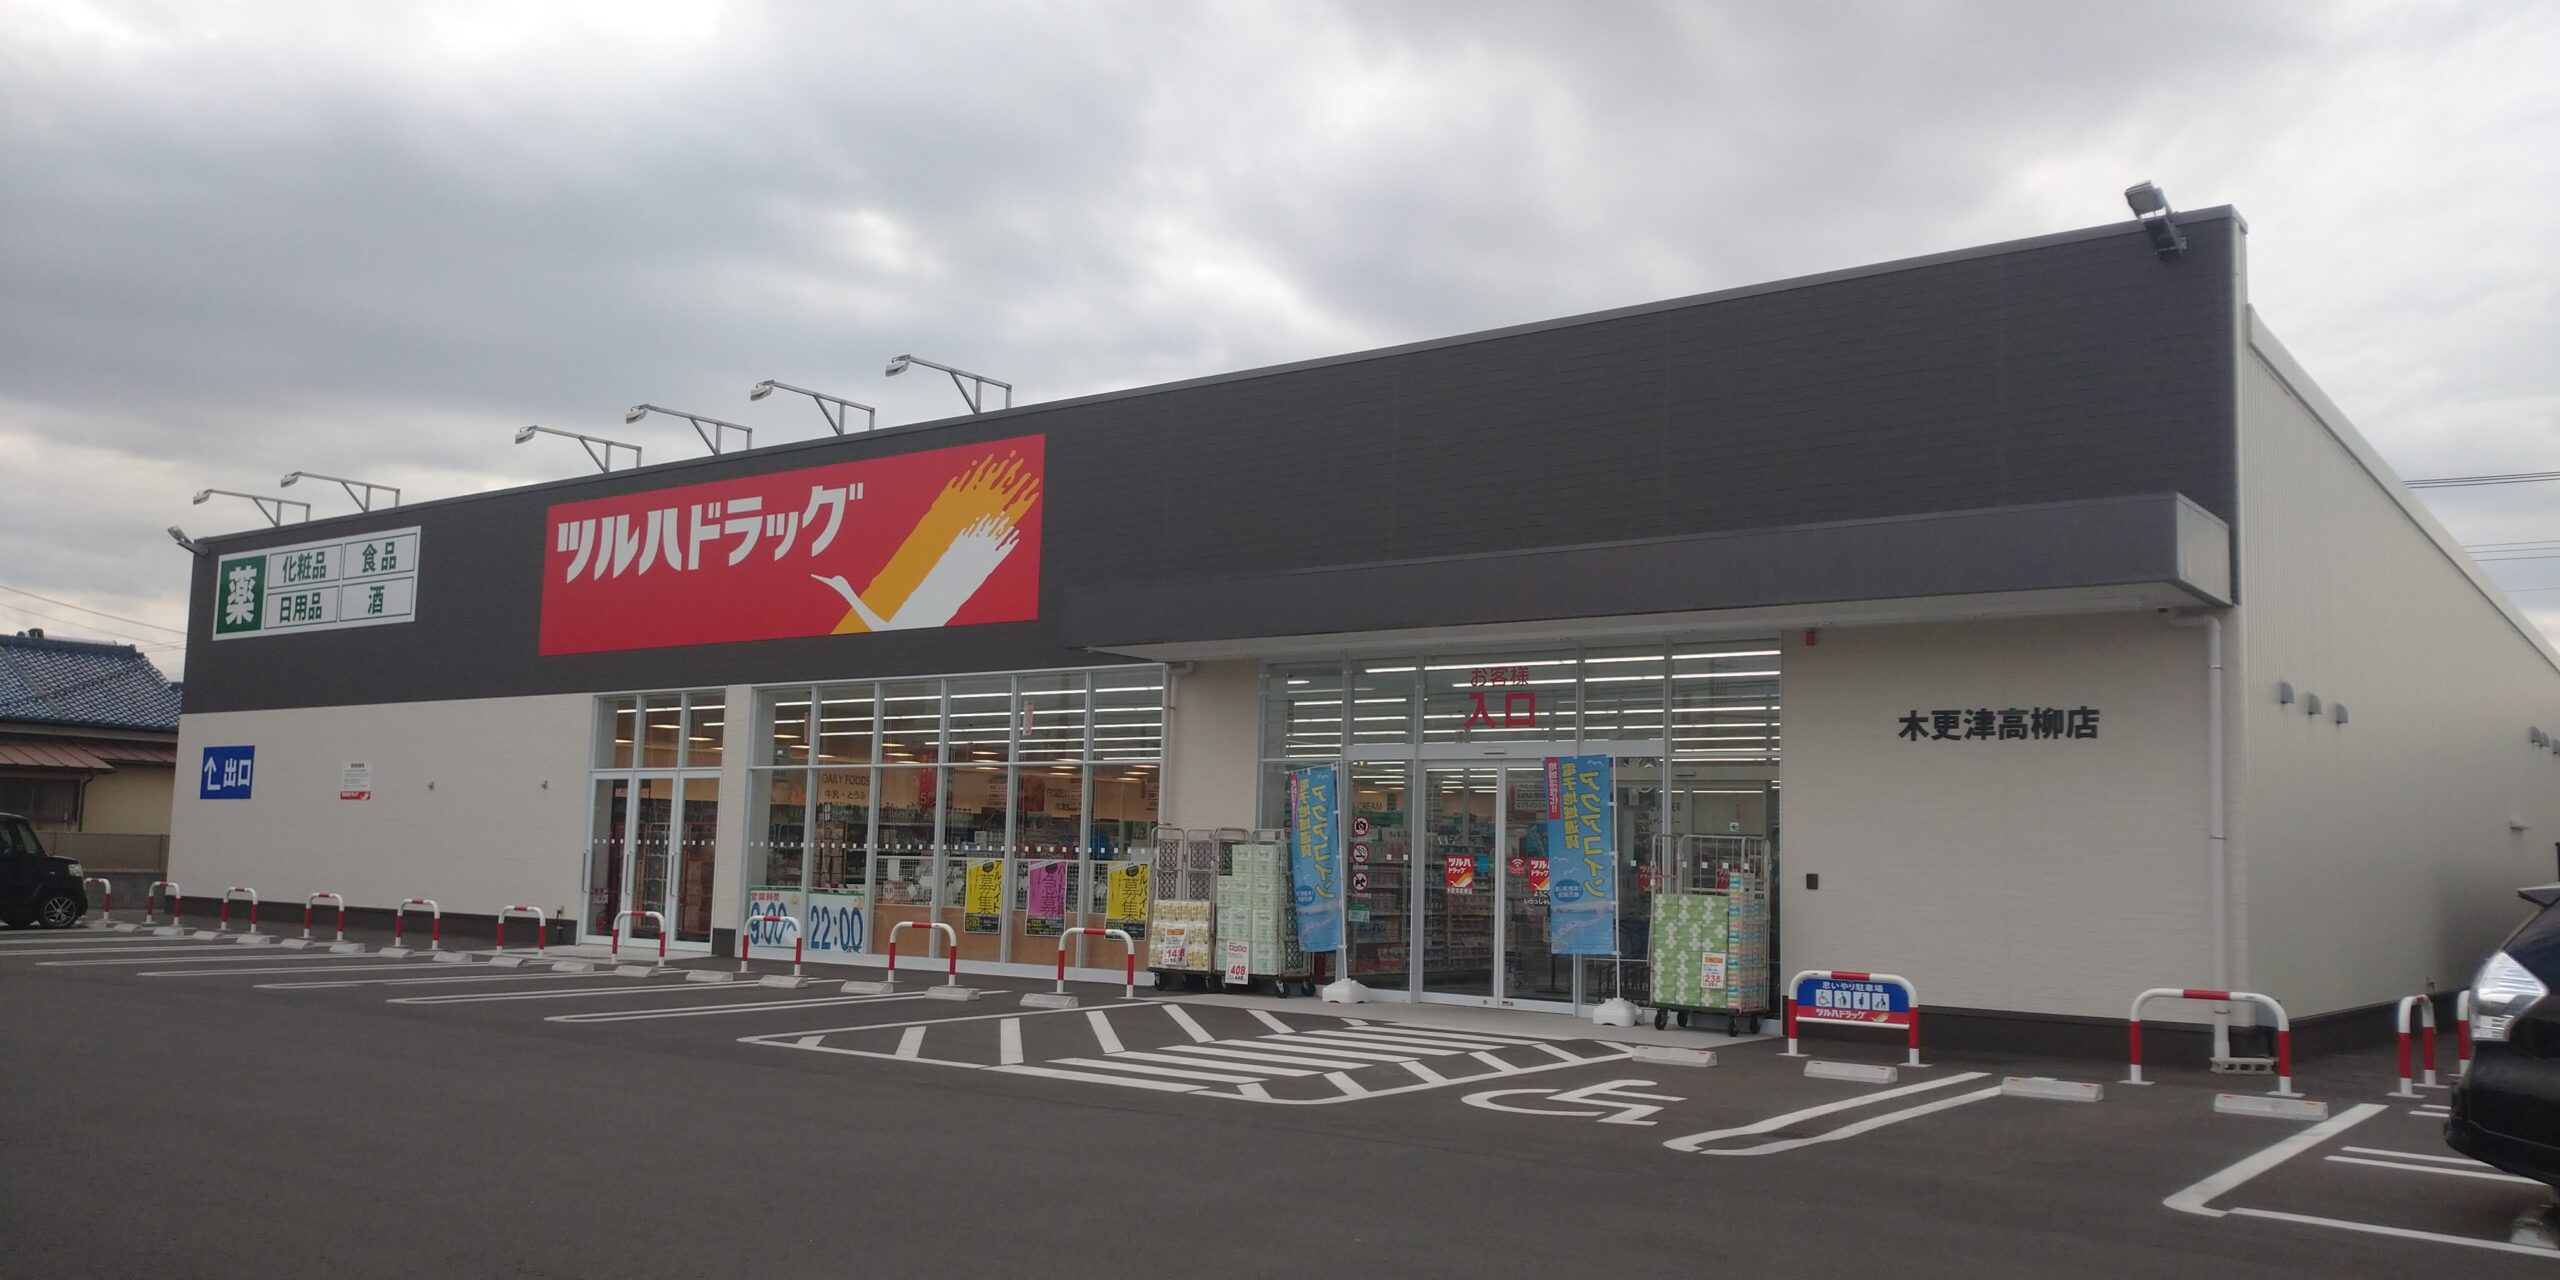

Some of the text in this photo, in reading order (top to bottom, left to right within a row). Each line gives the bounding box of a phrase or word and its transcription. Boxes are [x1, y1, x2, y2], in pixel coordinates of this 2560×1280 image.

[556, 482, 864, 584] ツルハドラッグ
[282, 551, 327, 583] 化粧品
[362, 541, 397, 573] 食品
[225, 565, 258, 625] 薬
[279, 592, 323, 623] 日用品
[367, 585, 385, 615] 酒
[1471, 666, 1530, 687] お客様
[1464, 690, 1536, 729] 入口
[1898, 705, 2100, 742] 木更津高柳店
[223, 758, 251, 788] 出口
[823, 773, 870, 786] DAILY FOODS
[1448, 857, 1472, 868] ツルハ
[978, 874, 994, 914] 募集
[1121, 878, 1140, 920] 募集
[1139, 864, 1148, 919] アルバイト
[810, 905, 863, 952] 22:00
[1230, 965, 1246, 976] 408
[1704, 975, 1721, 983] 238
[1822, 981, 1884, 993] 思いやり駐車場
[1816, 1008, 1868, 1020] ツルハドラッグ
